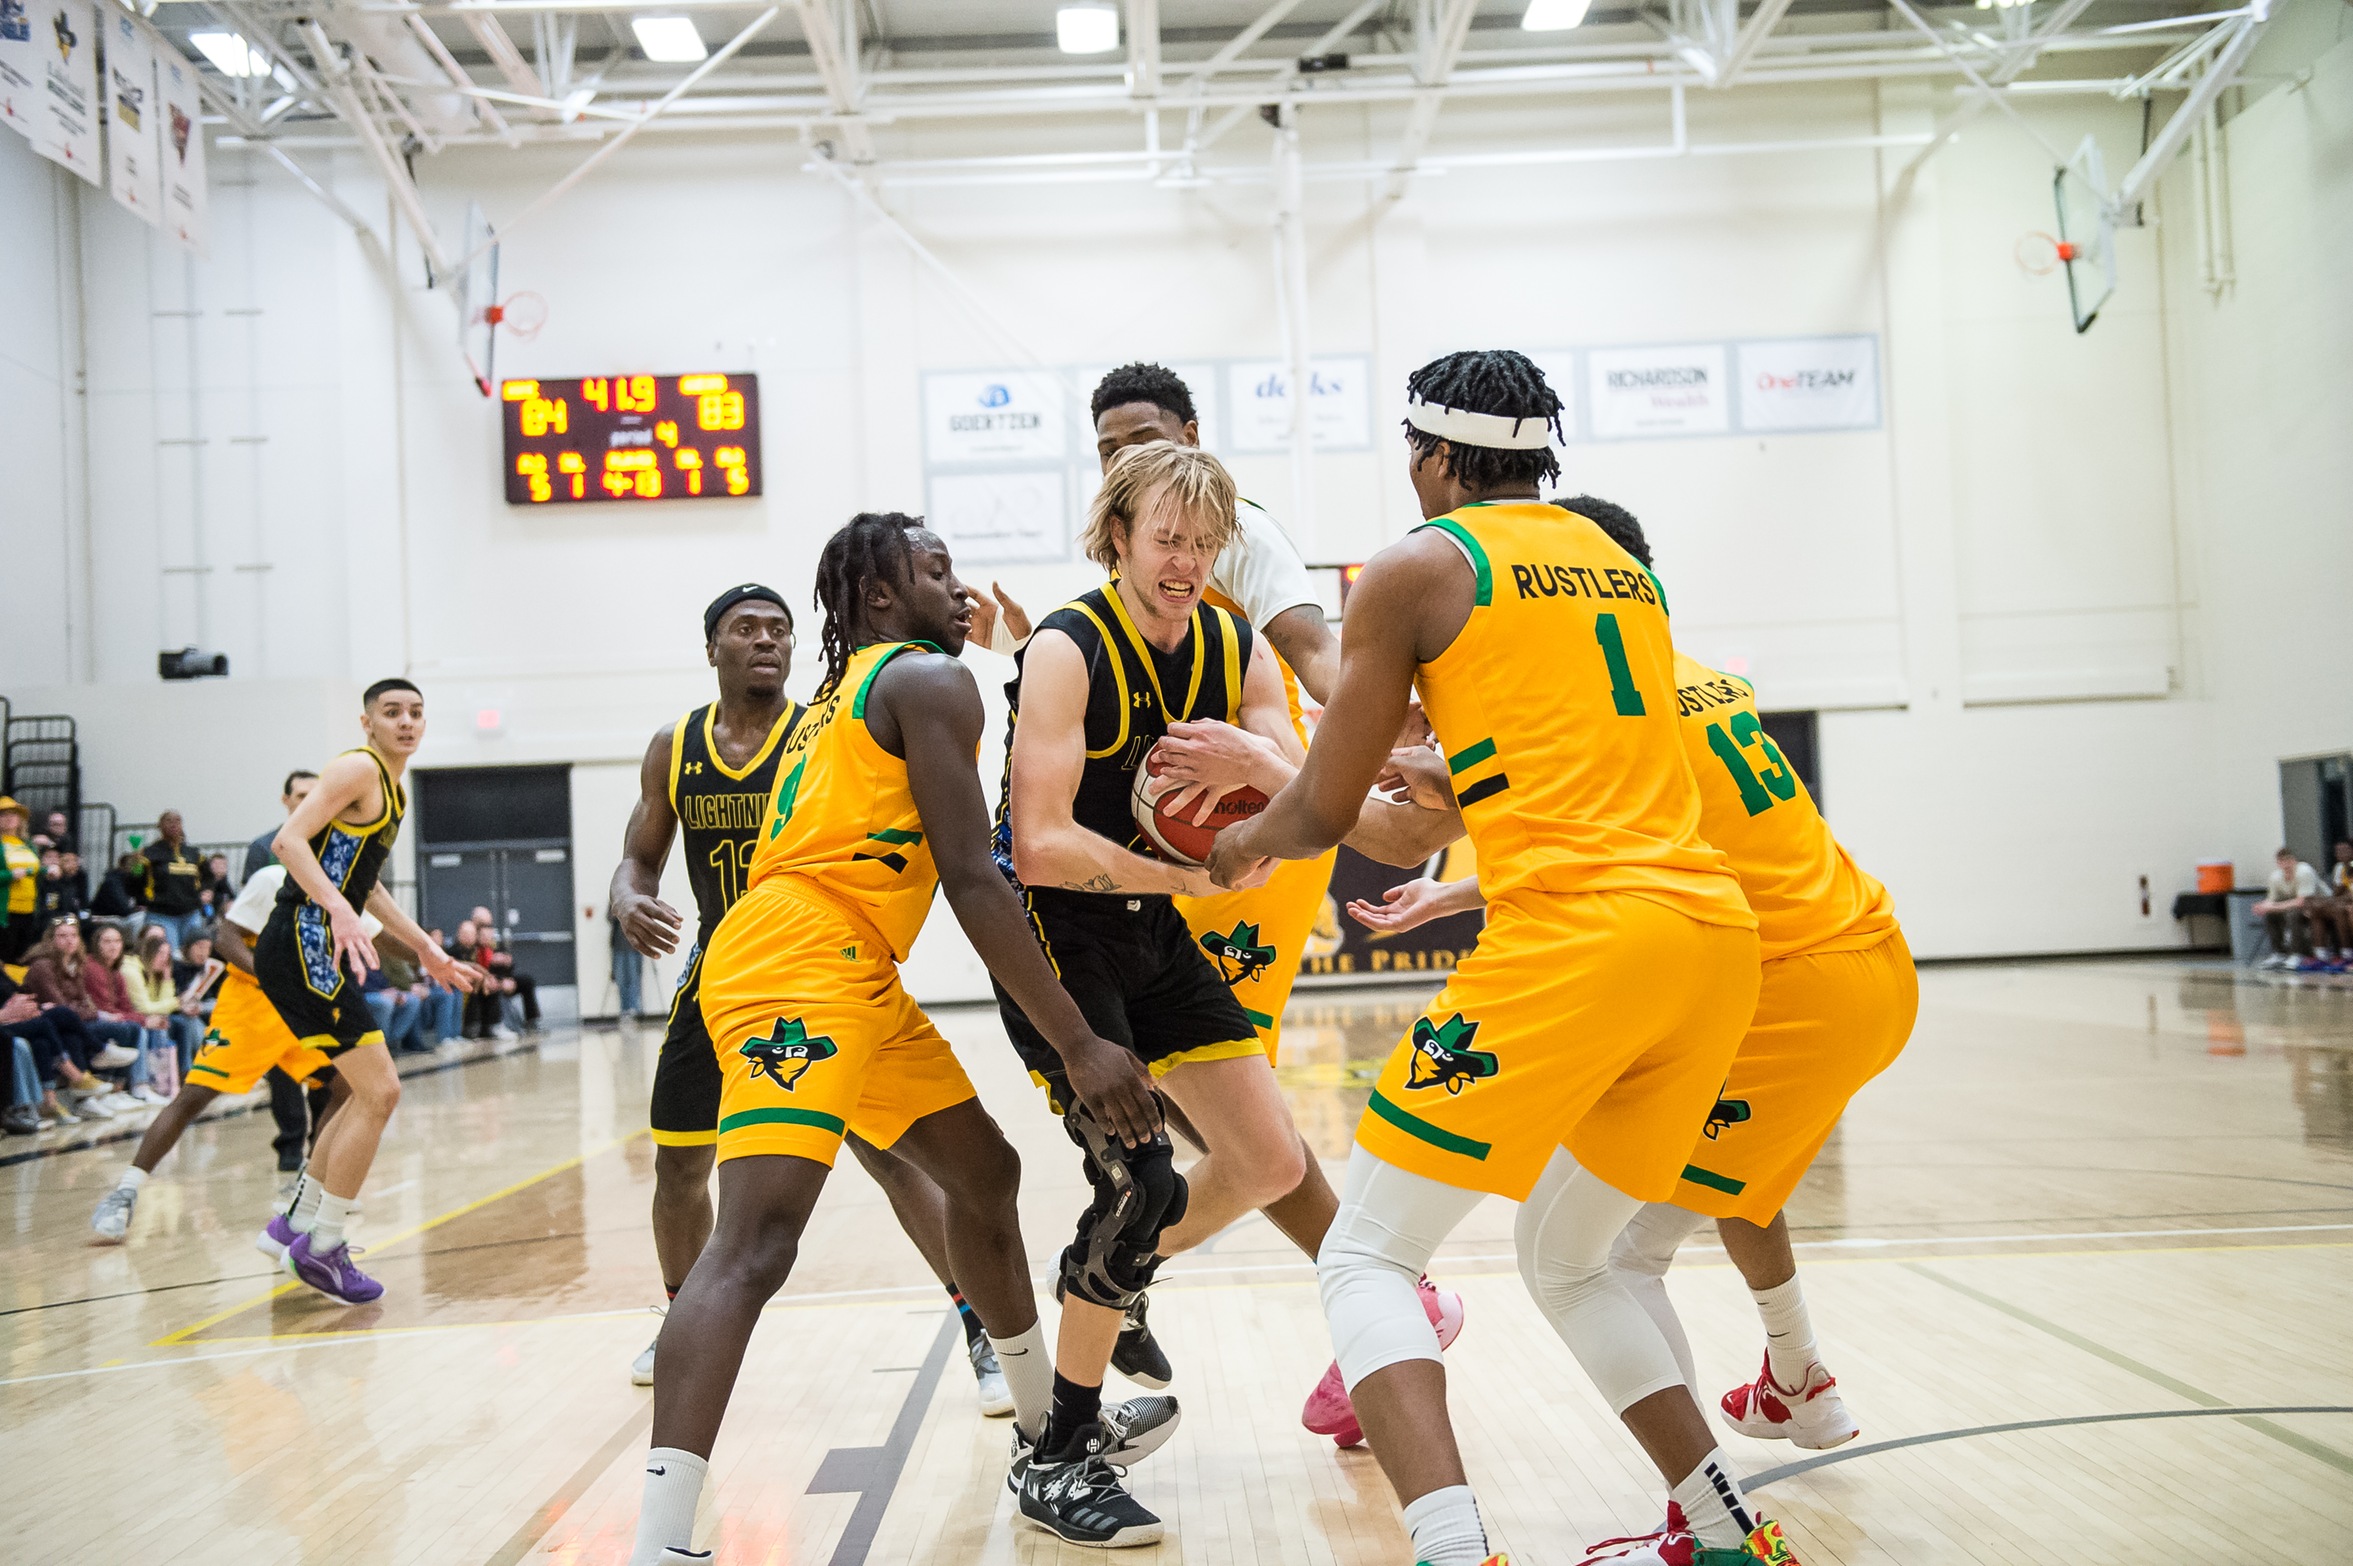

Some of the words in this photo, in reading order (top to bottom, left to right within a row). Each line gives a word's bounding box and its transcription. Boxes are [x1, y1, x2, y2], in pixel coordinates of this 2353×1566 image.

[1607, 366, 1708, 387] RICHARDSON
[1757, 368, 1856, 391] OneTEAM
[1511, 564, 1656, 605] RUSTLERS
[1595, 612, 1646, 716] 1
[1706, 710, 1796, 817] 13
[685, 793, 771, 829] LIGHTNI
